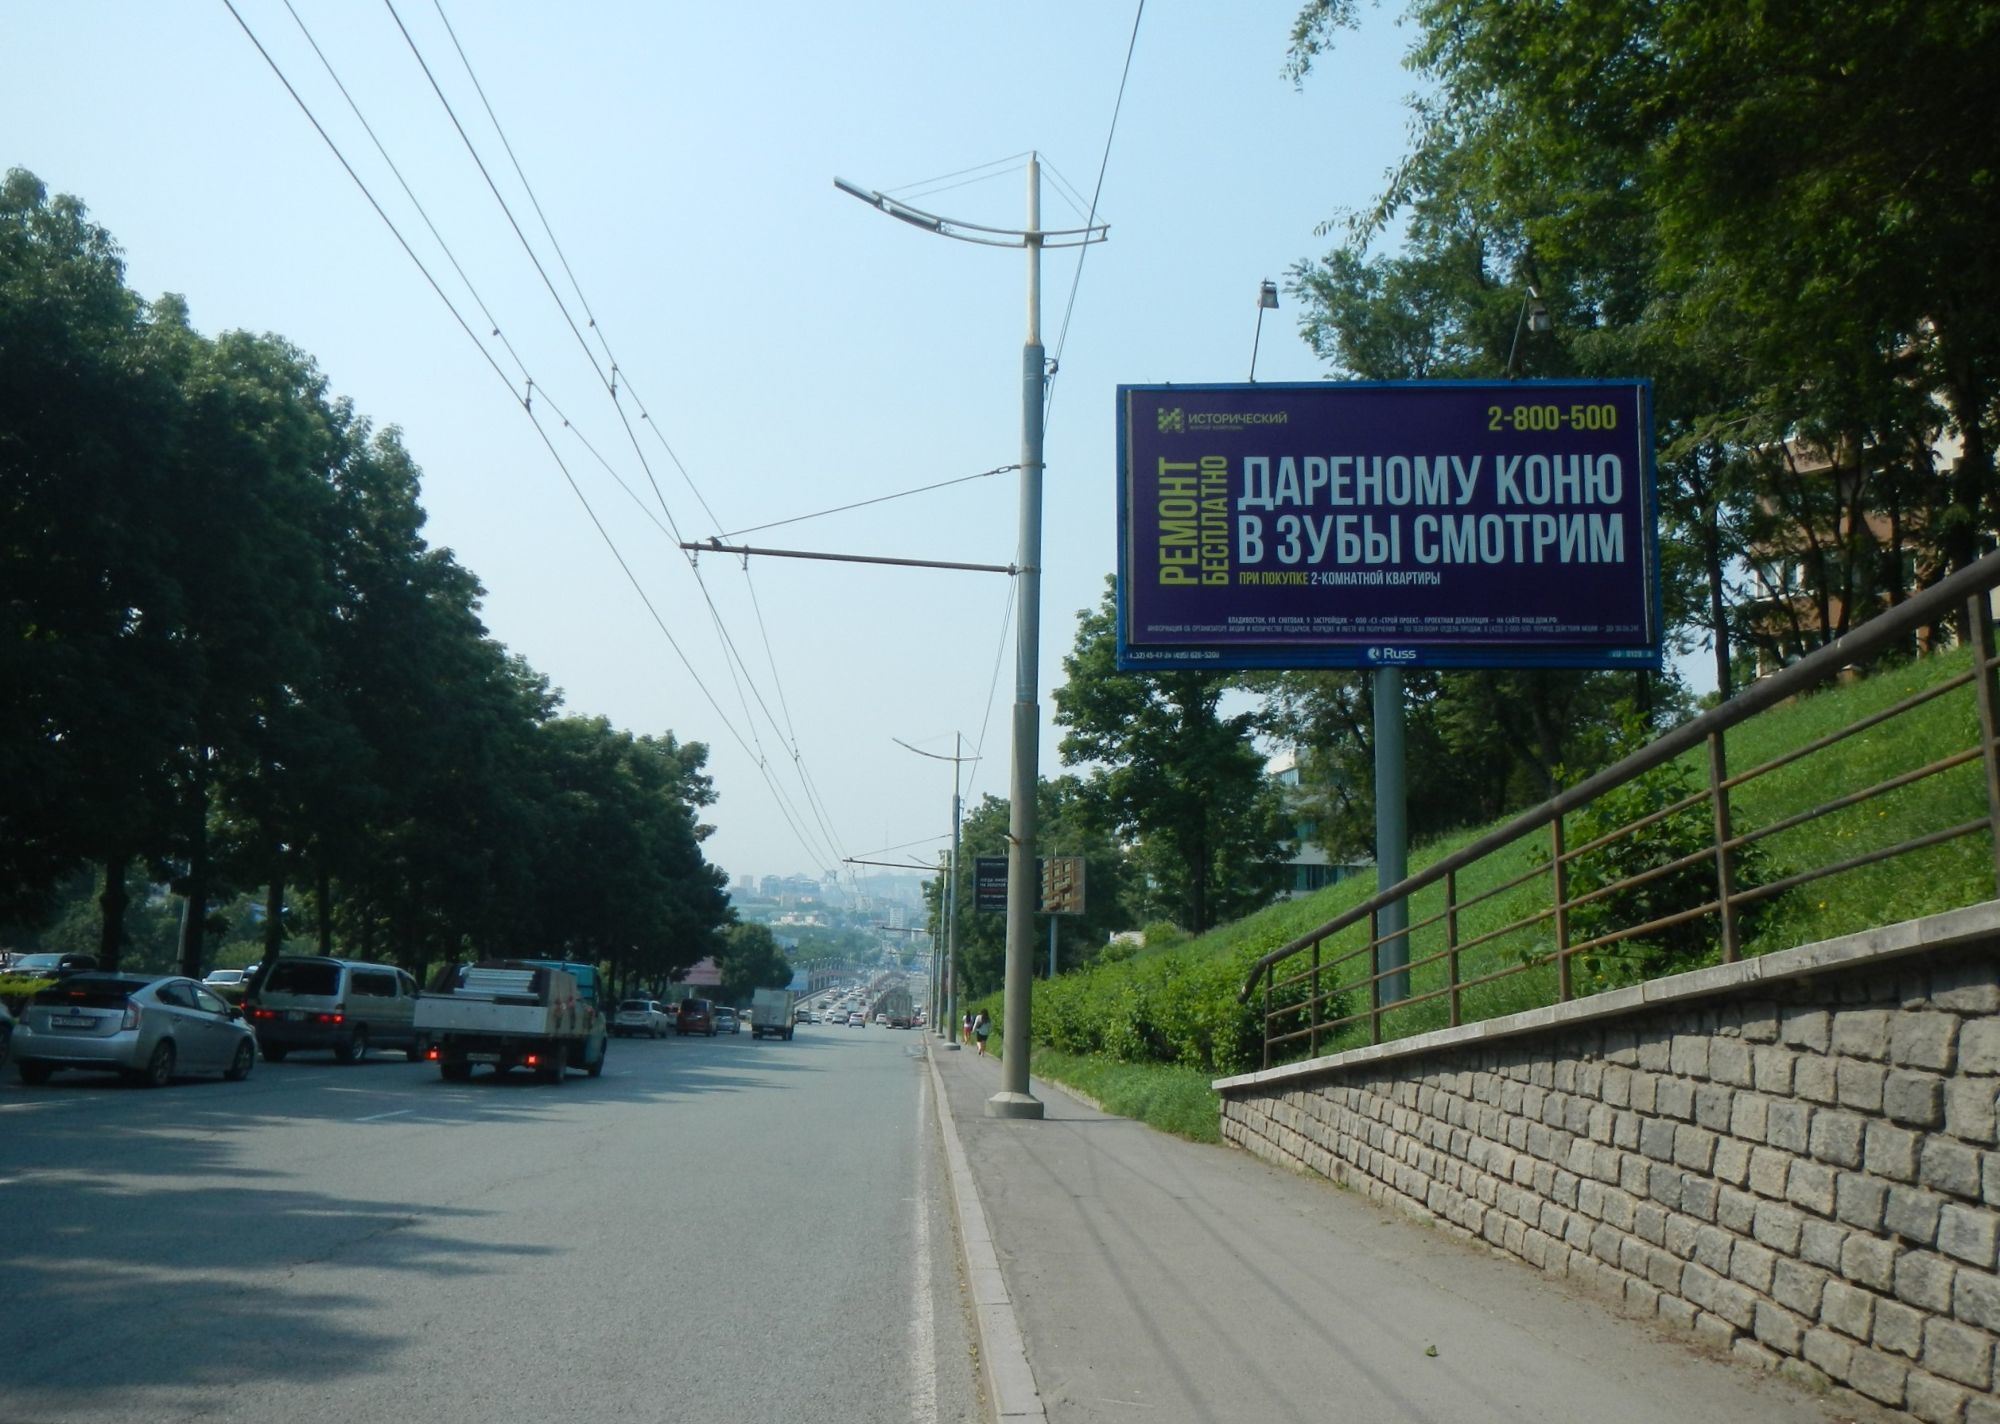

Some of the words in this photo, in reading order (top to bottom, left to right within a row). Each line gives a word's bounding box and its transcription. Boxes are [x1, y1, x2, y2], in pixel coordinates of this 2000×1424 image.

[1188, 411, 1288, 424] ИСТОРИЧЕСКИЙ
[1488, 404, 1617, 430] 2-800-500
[1238, 455, 1480, 510] ДАРЕНОМУ
[1497, 454, 1623, 506] КОНЮ
[1158, 456, 1198, 585] РЕМОНТ
[1200, 455, 1228, 585] БЕСПЛАТНО
[1238, 514, 1263, 564] В
[1276, 514, 1401, 564] ЗУБЫ
[1414, 513, 1625, 563] СМОТРИМ
[1239, 571, 1259, 585] ПРИ
[1261, 571, 1309, 585] ПОКУПКЕ
[1310, 569, 1384, 585] 2-КОМНАТНОЙ
[1385, 571, 1440, 585] КВАРТИРЫ
[1383, 647, 1417, 659] Russ
